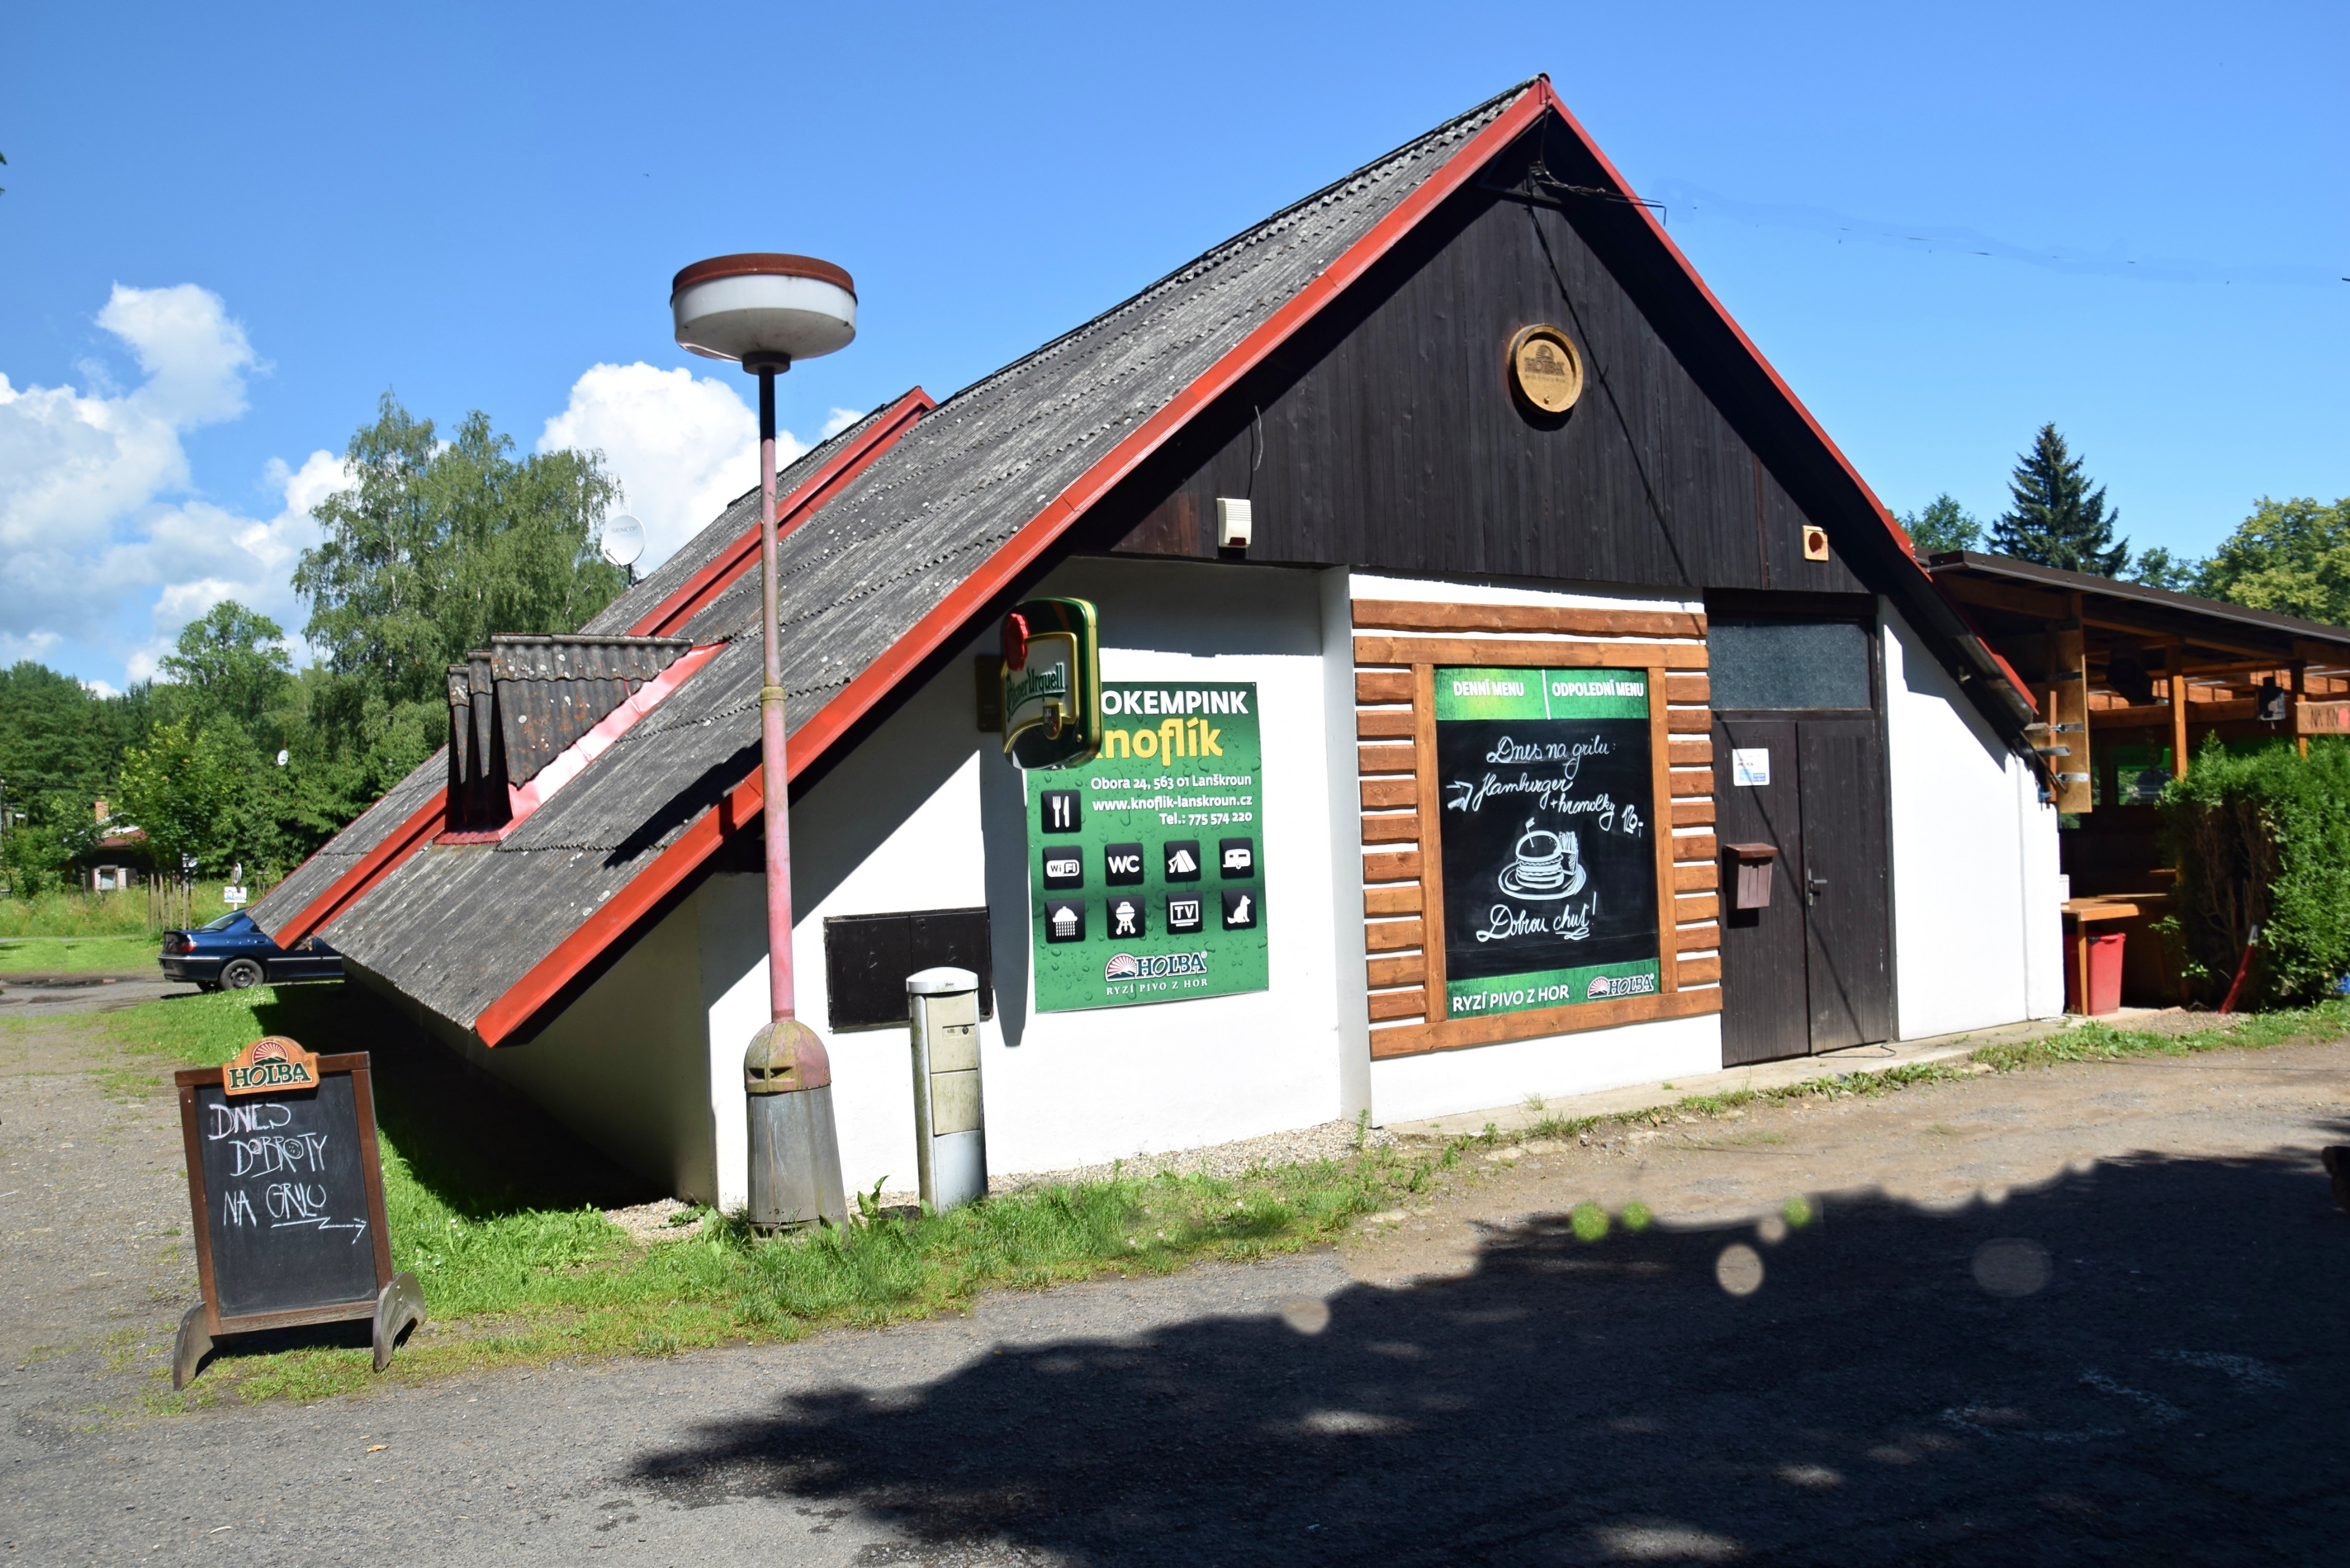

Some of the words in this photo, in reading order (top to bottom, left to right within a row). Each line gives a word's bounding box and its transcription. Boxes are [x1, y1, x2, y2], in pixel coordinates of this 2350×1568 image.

[1027, 660, 1065, 702] Urquell
[1453, 679, 1490, 696] DENNÍ
[1492, 681, 1525, 697] MENU
[1552, 679, 1615, 697] ODPOLEDNÍ
[1616, 682, 1644, 697] MENU
[1096, 716, 1224, 767] noflík
[1486, 736, 1543, 763] Dnes
[1546, 743, 1567, 758] na
[1090, 777, 1130, 790] Obora
[1133, 779, 1151, 791] 24,
[1154, 776, 1174, 790] 563
[1192, 774, 1252, 787] Lanškroun
[1472, 771, 1574, 812] Hamburger
[1092, 795, 1253, 811] www.knoflik-lanskroun.cz
[1159, 812, 1186, 825] Tel.:
[1189, 814, 1208, 826] 775
[1211, 813, 1230, 825] 574
[1232, 811, 1253, 822] 220
[1107, 855, 1140, 874] WC
[1174, 905, 1194, 919] TV
[1476, 904, 1549, 942] Dobrou
[1135, 953, 1207, 978] HOLBA
[1106, 983, 1134, 995] RYZÍ
[1140, 982, 1167, 992] PIVO
[1171, 981, 1179, 989] Z
[1184, 978, 1208, 988] HOR
[1452, 991, 1487, 1012] RYZÍ
[1490, 990, 1524, 1008] PIVO
[1527, 989, 1535, 1003] Z
[1538, 984, 1569, 1002] HOR
[1607, 975, 1654, 996] HOLBA
[227, 1061, 313, 1090] HOLBA
[208, 1099, 291, 1140] DNES
[228, 1132, 328, 1178] DOBROTY
[223, 1190, 257, 1227] NA
[266, 1182, 327, 1220] GRILU
